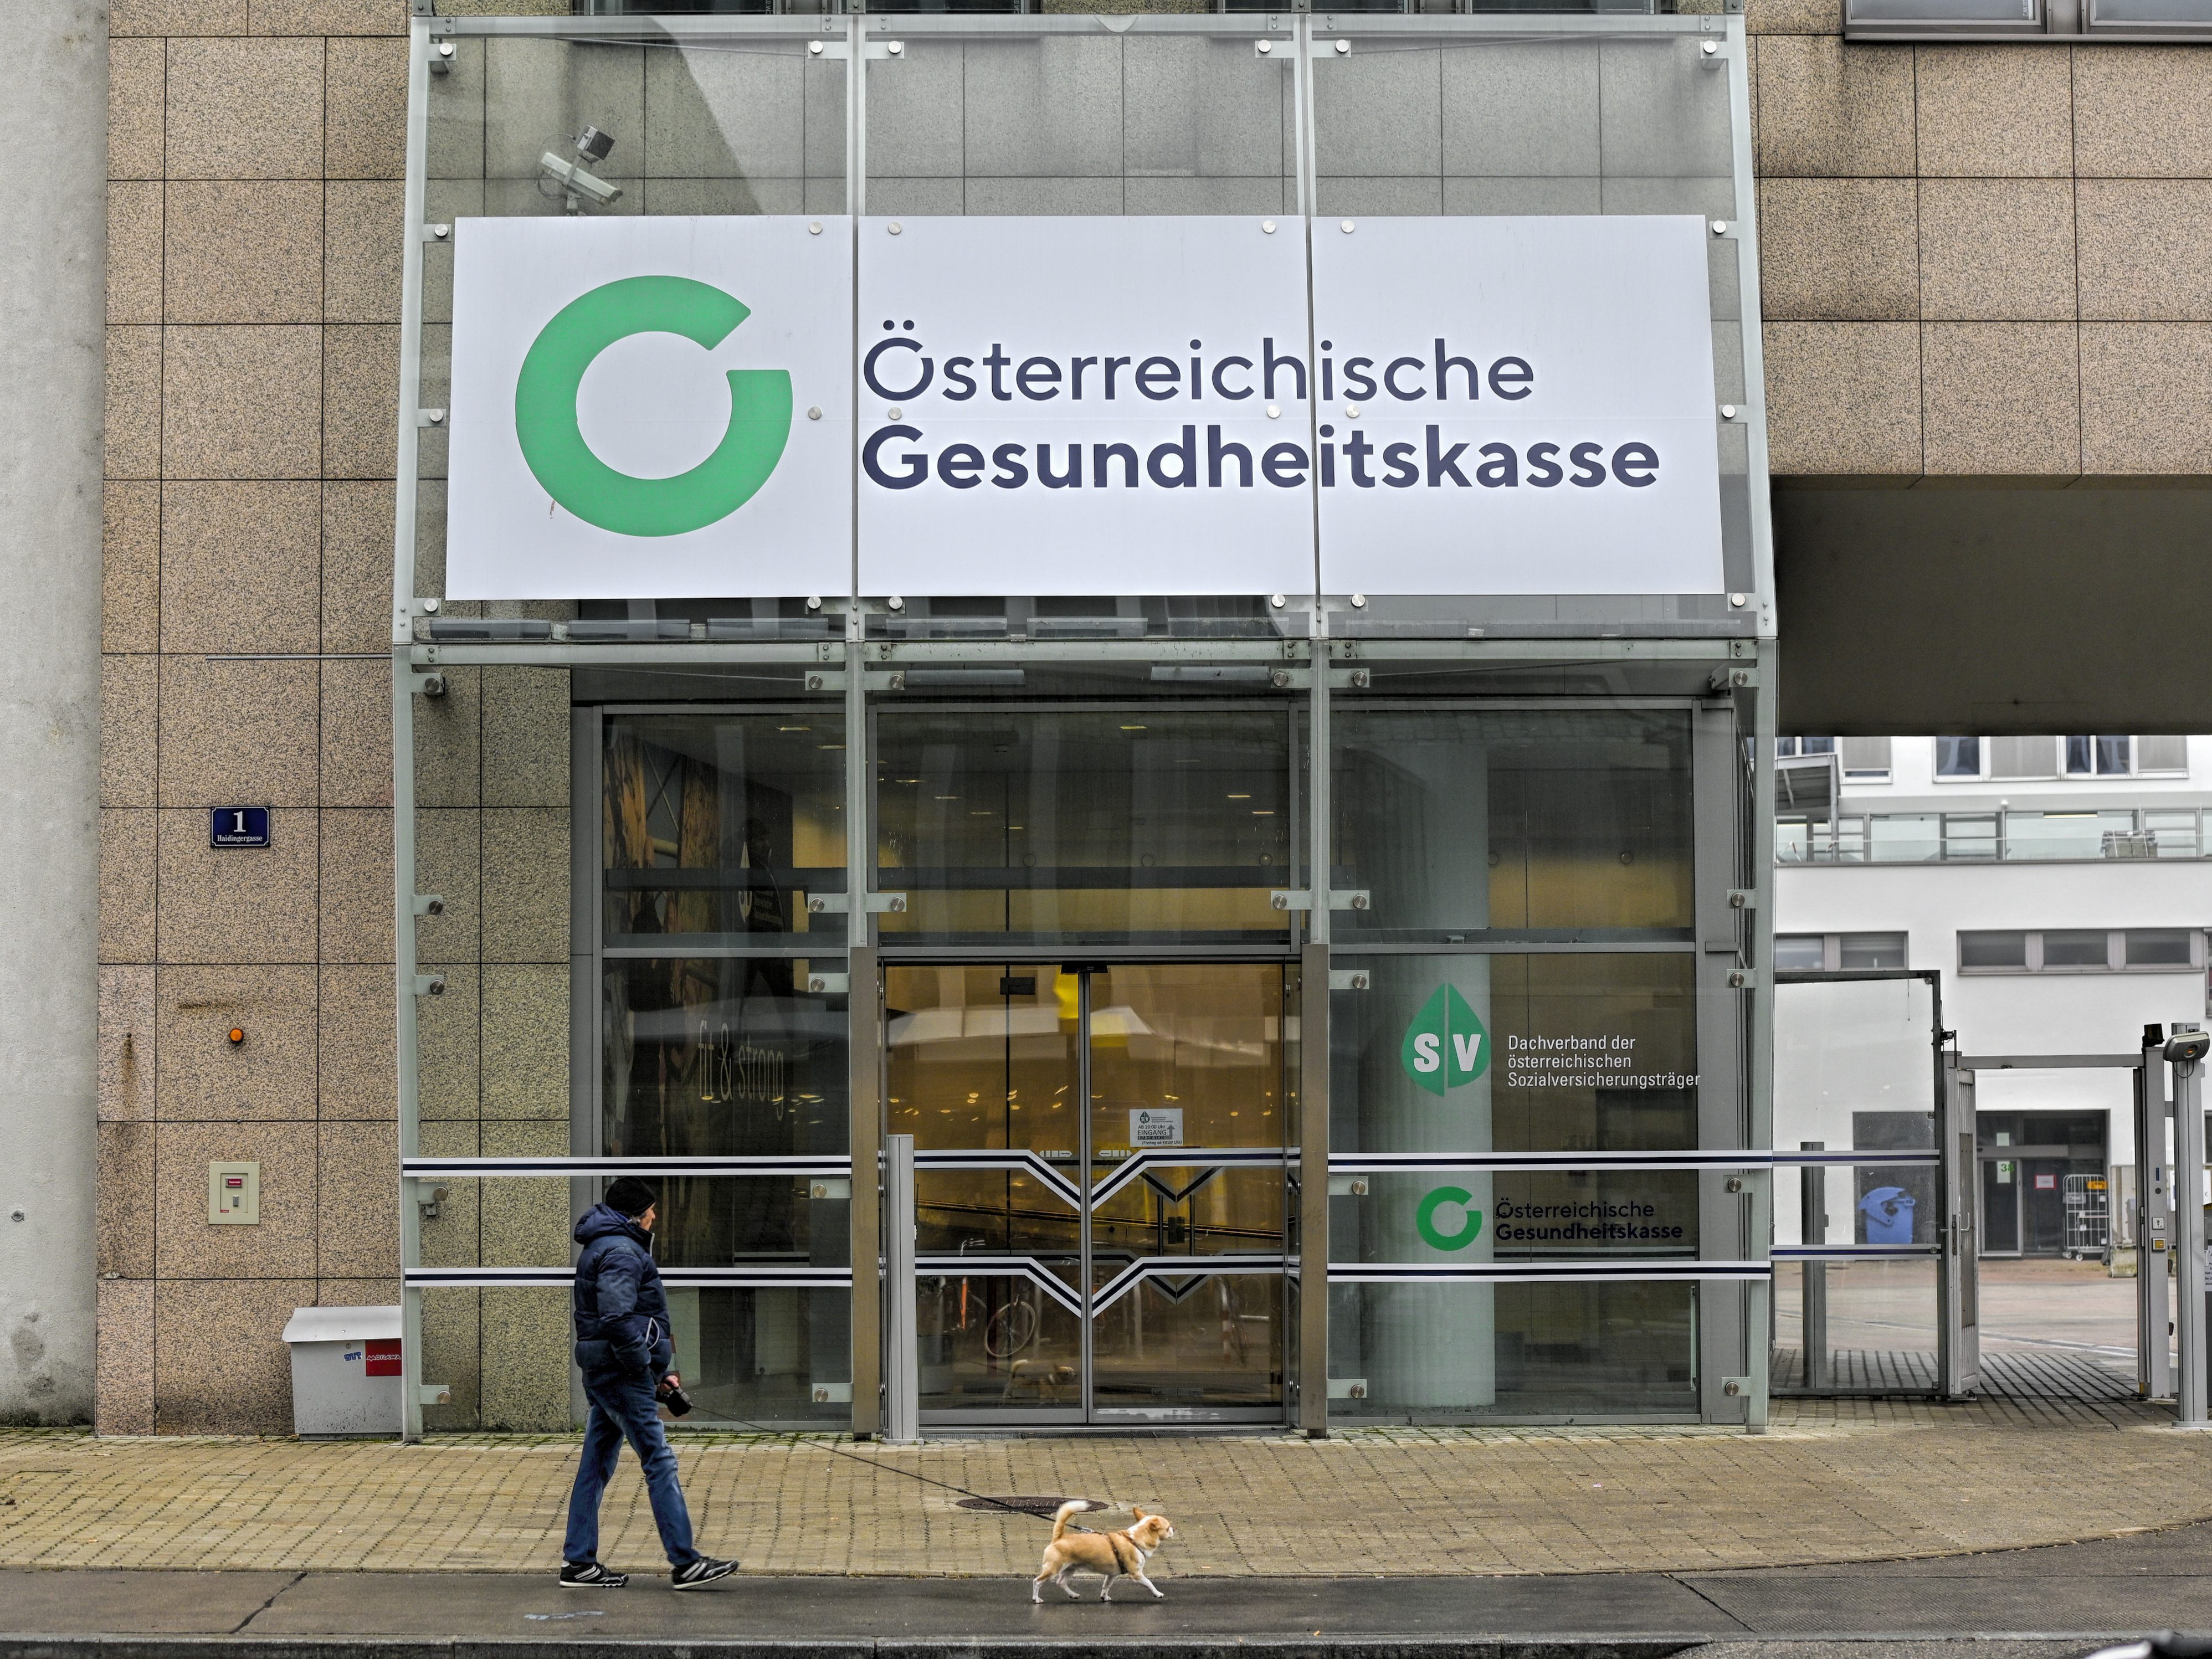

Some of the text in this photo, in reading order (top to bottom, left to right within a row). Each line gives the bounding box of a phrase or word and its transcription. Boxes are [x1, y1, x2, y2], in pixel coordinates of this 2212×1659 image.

[864, 320, 1534, 401] Österreichische
[862, 424, 1660, 489] Gesundheitskasse
[233, 810, 246, 832] 1
[217, 834, 263, 843] Haidingergasse
[1508, 1035, 1636, 1051] Dachverband der
[1507, 1054, 1632, 1069] österreichischen
[718, 1023, 732, 1101] &
[738, 1034, 784, 1121] strong
[1507, 1070, 1701, 1090] Sozialversicherungsträger
[1496, 1198, 1655, 1218] Österreichische
[1496, 1222, 1683, 1240] Gesundheitskasse
